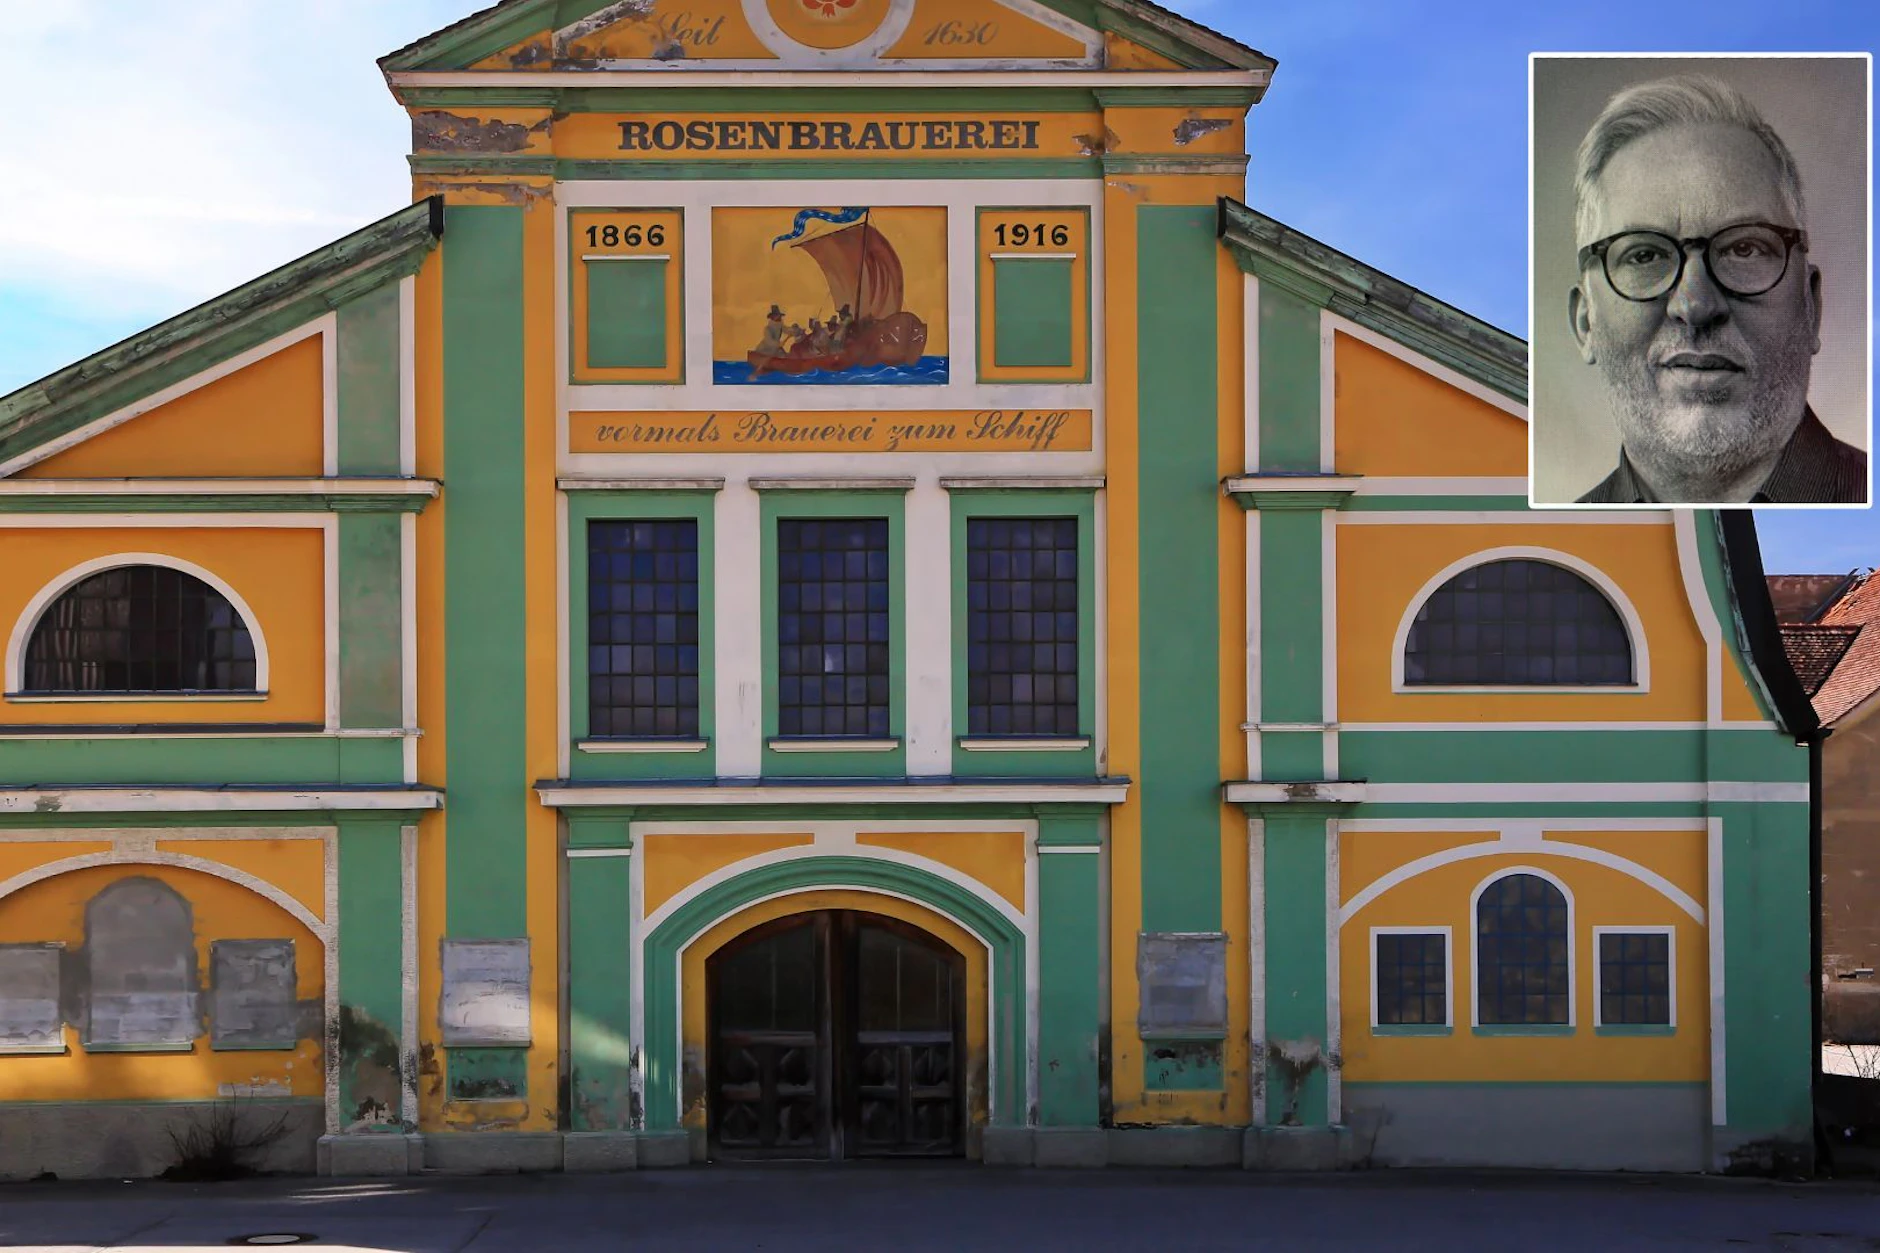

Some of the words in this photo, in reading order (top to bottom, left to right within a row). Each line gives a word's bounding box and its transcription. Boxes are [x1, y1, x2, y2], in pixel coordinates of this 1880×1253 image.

[923, 18, 1000, 46] 1630
[617, 121, 1040, 150] ROSENBRAUEREI
[585, 224, 666, 248] 1866
[994, 223, 1070, 247] 1916
[596, 413, 721, 443] vormals
[733, 411, 877, 443] Brauerei
[884, 423, 957, 451] zum
[966, 410, 1070, 450] Schiff
